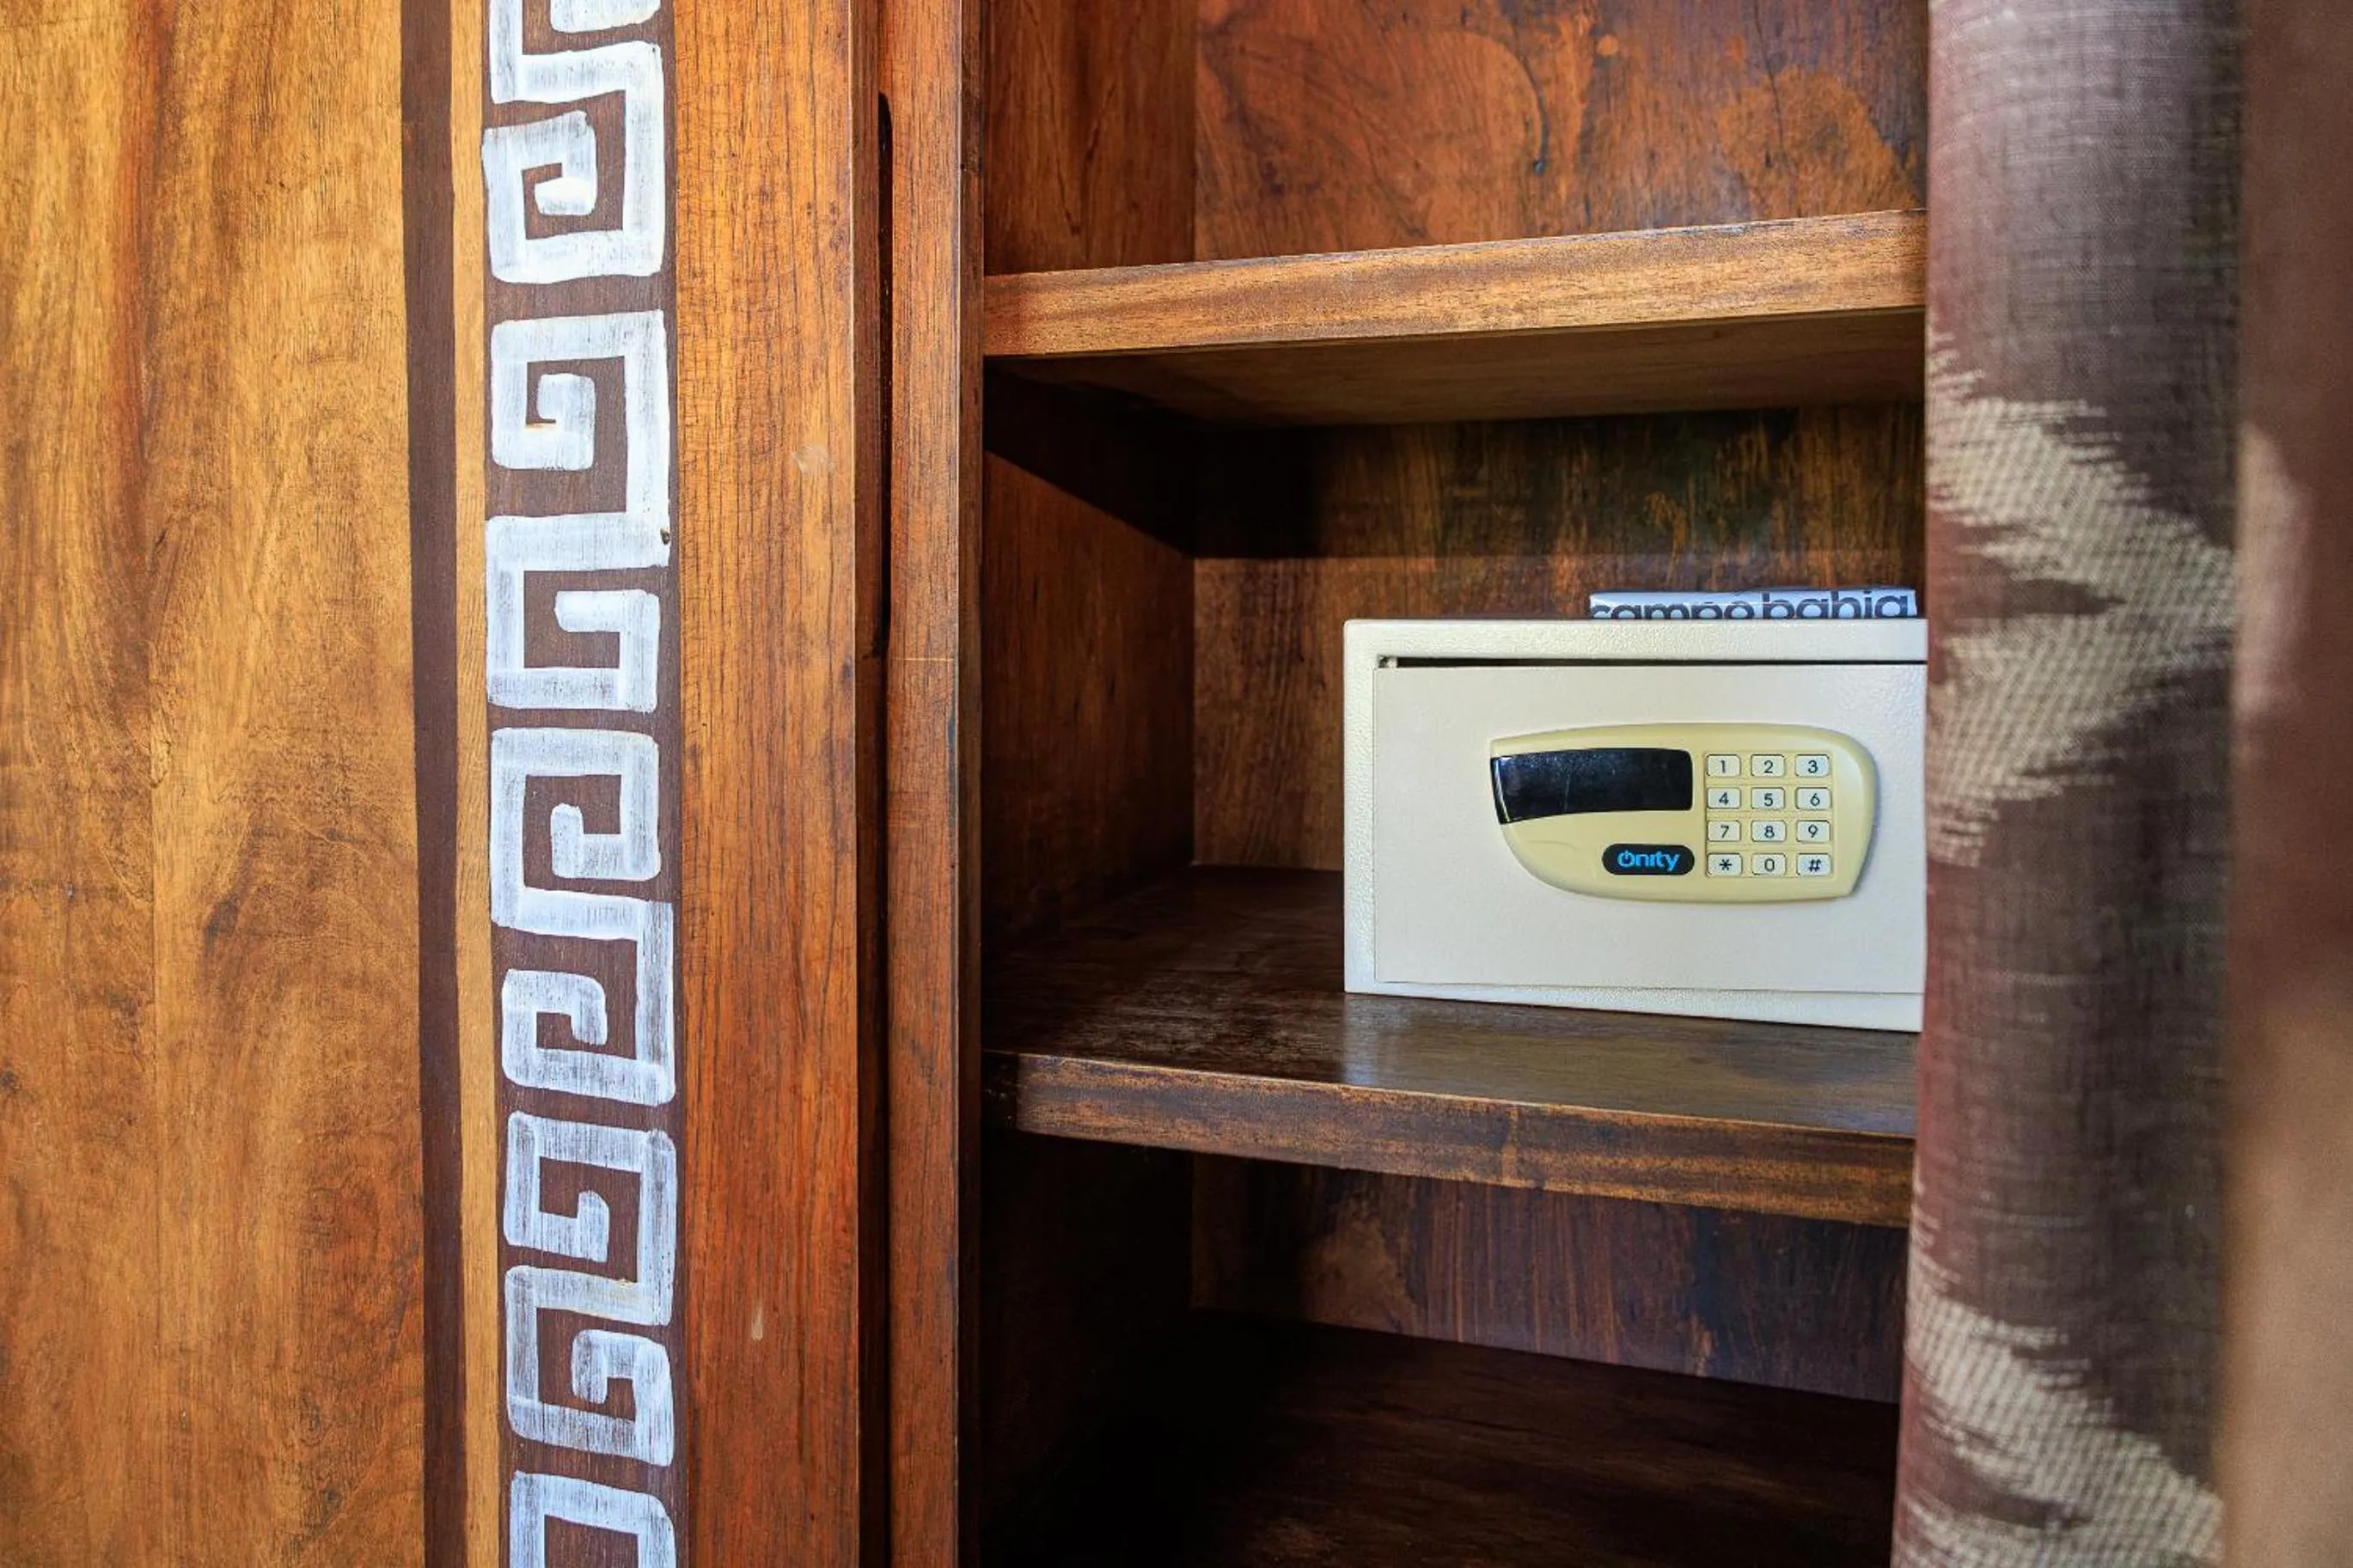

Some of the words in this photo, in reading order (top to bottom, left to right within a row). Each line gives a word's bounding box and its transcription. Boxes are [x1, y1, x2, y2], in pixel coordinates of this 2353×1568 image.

[1762, 590, 1909, 619] bahia
[1720, 760, 1727, 773] 1
[1763, 760, 1774, 774] 2
[1807, 760, 1818, 774] 3
[1719, 791, 1729, 806] 4
[1763, 792, 1774, 807] 5
[1809, 792, 1821, 807] 6
[1720, 825, 1730, 839] 7
[1763, 825, 1775, 839] 8
[1807, 824, 1818, 839] 9
[1617, 850, 1680, 871] Onity
[1763, 857, 1775, 872] 0
[1807, 858, 1822, 873] #
